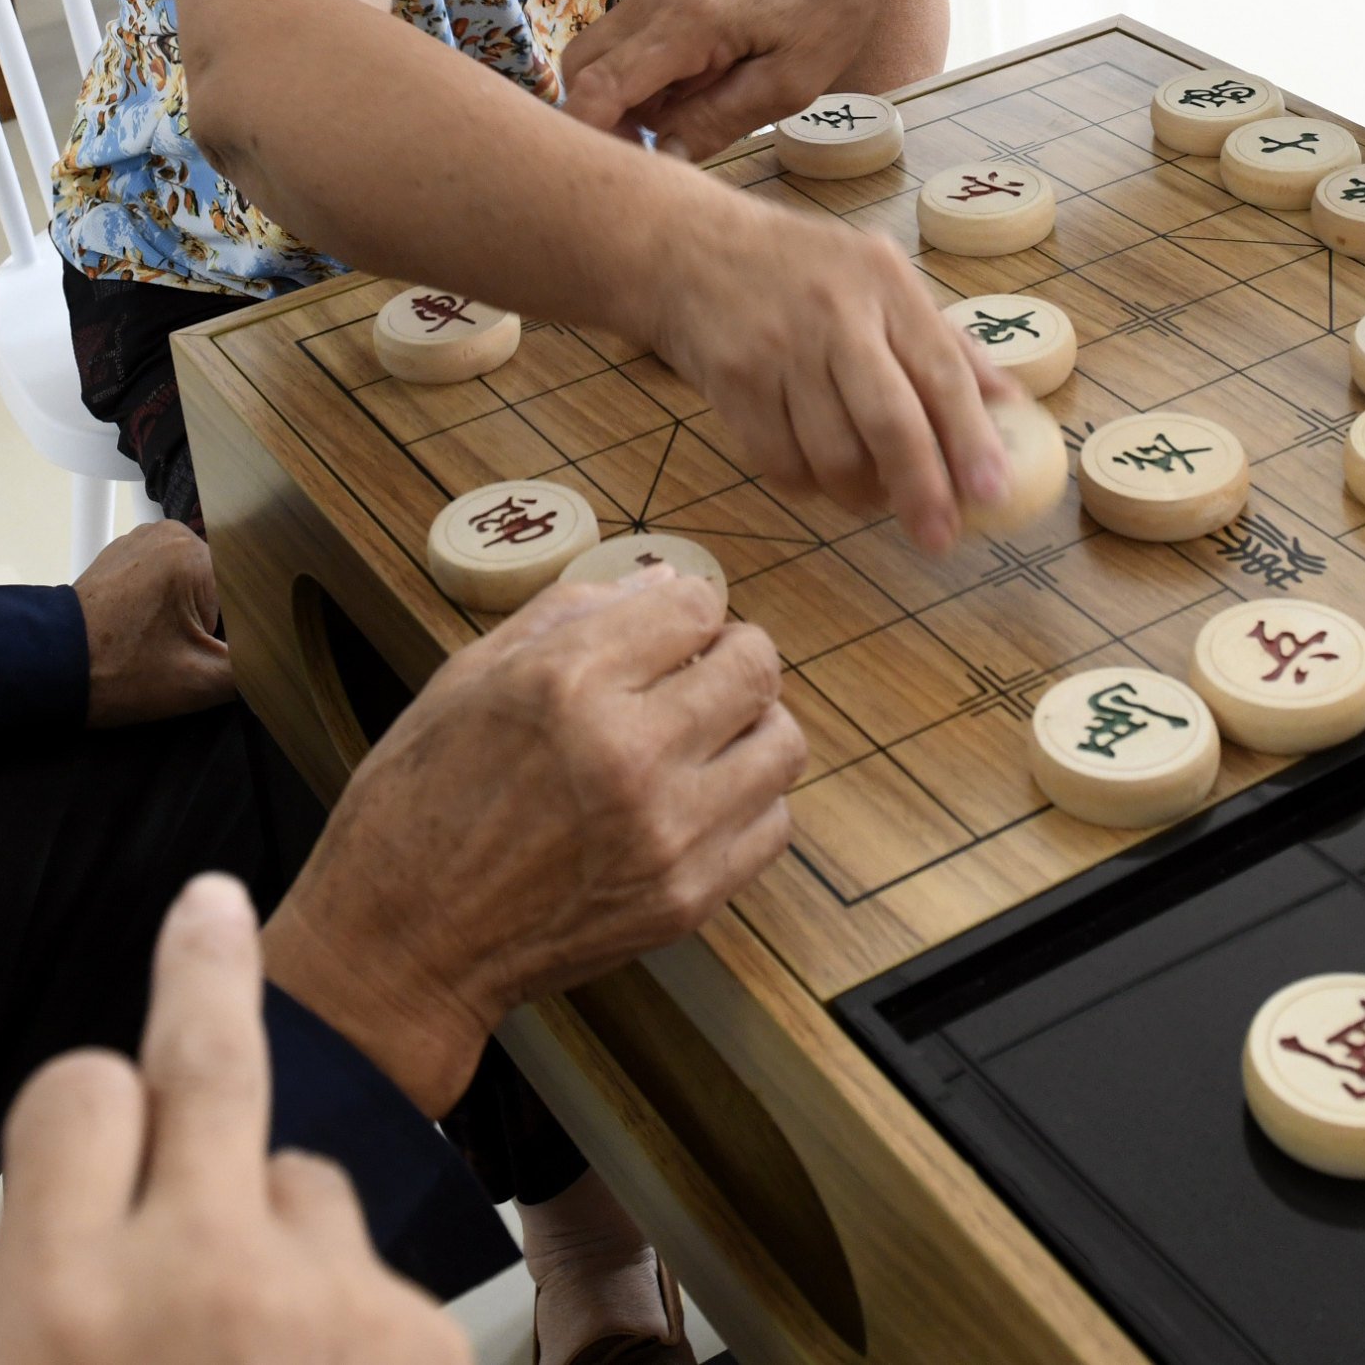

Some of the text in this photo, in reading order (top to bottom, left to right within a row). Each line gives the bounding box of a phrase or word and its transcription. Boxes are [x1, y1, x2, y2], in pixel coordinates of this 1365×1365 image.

[1177, 79, 1256, 109] 象
[800, 103, 878, 131] 卒
[1258, 132, 1320, 155] 士
[946, 171, 1025, 202] 兵
[1111, 433, 1212, 474] 卒
[468, 496, 558, 548] 帥
[1247, 620, 1340, 684] 兵
[1076, 681, 1190, 759] 馬
